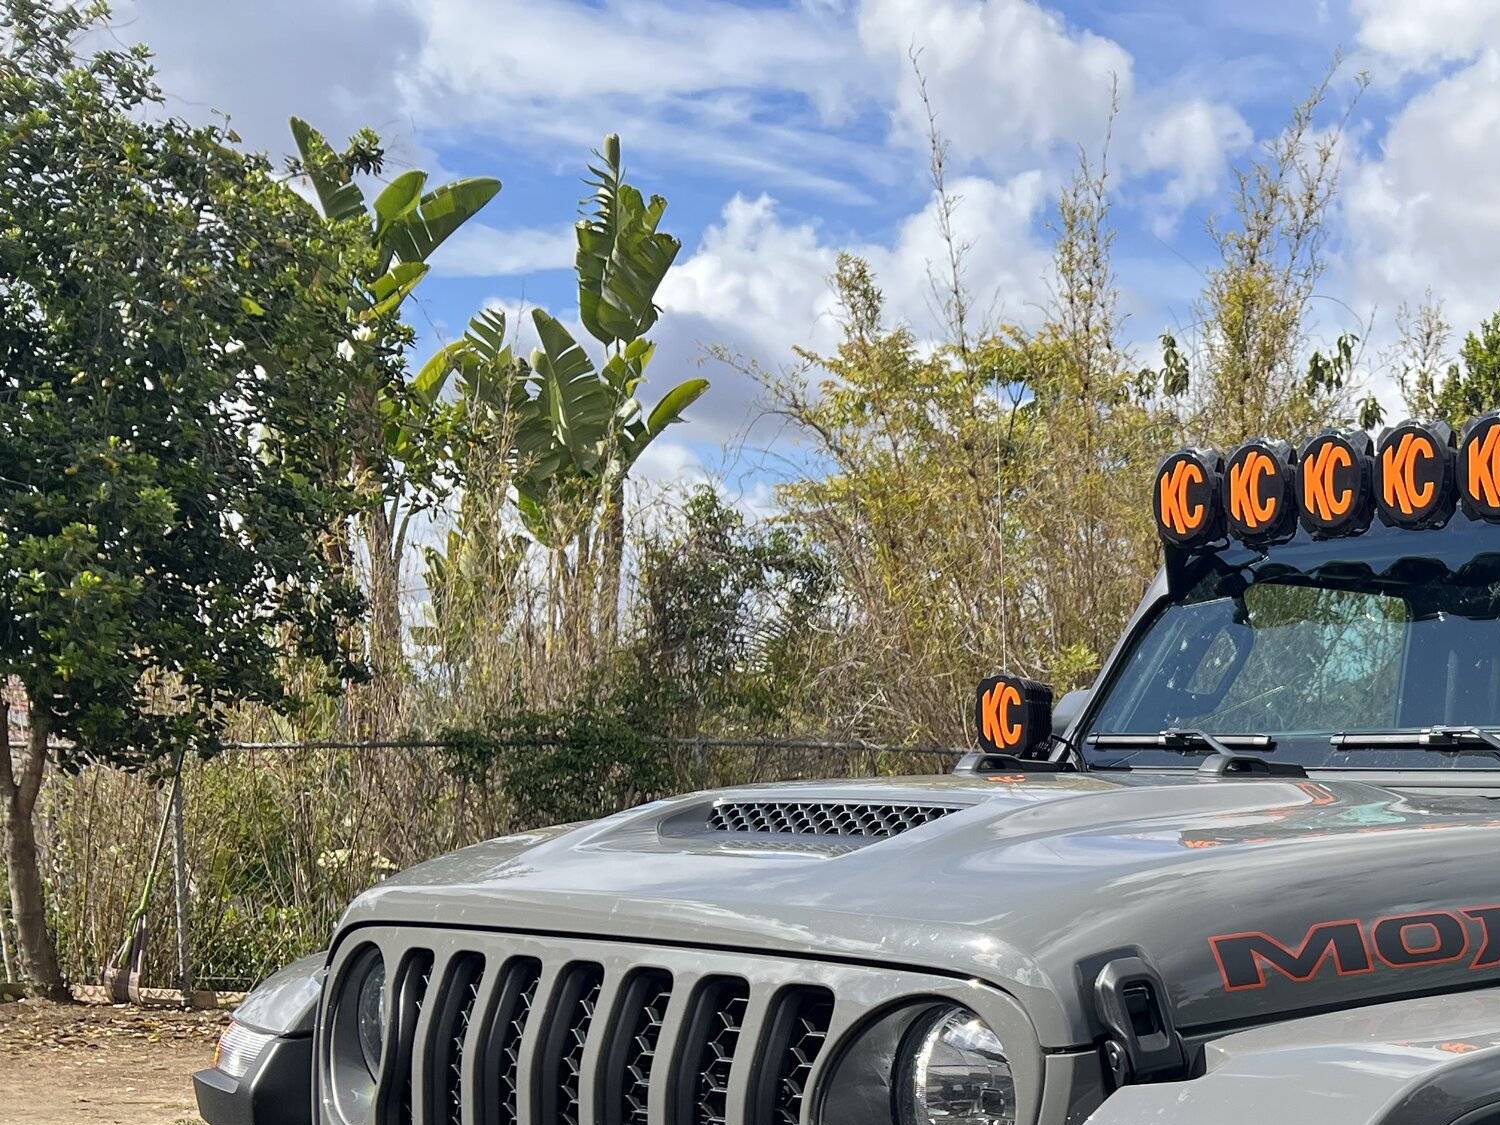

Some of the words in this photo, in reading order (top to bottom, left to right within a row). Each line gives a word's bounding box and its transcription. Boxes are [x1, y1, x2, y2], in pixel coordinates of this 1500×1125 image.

[1161, 463, 1205, 532] KC
[1231, 454, 1276, 526] KC
[1305, 444, 1353, 519] KC
[1384, 434, 1435, 514] KC
[982, 682, 1022, 748] KC
